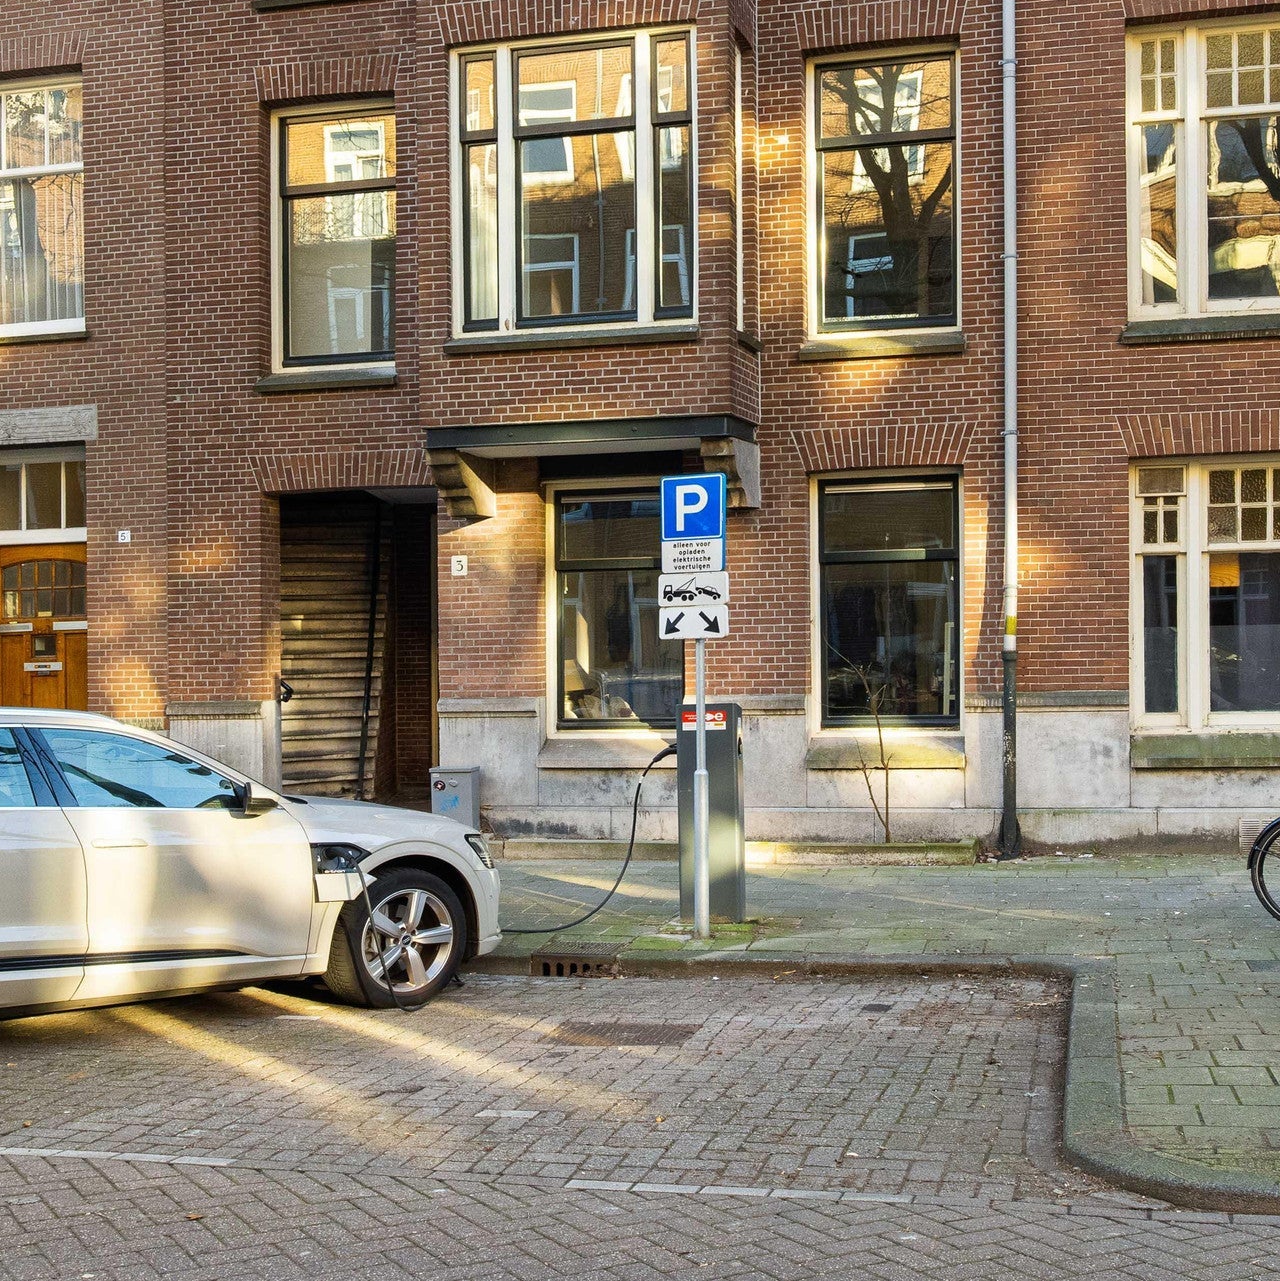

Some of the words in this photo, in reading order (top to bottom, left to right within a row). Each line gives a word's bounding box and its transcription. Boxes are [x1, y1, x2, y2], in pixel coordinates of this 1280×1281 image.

[675, 484, 709, 532] P
[456, 560, 464, 572] 3
[673, 563, 711, 571] voertuigen
